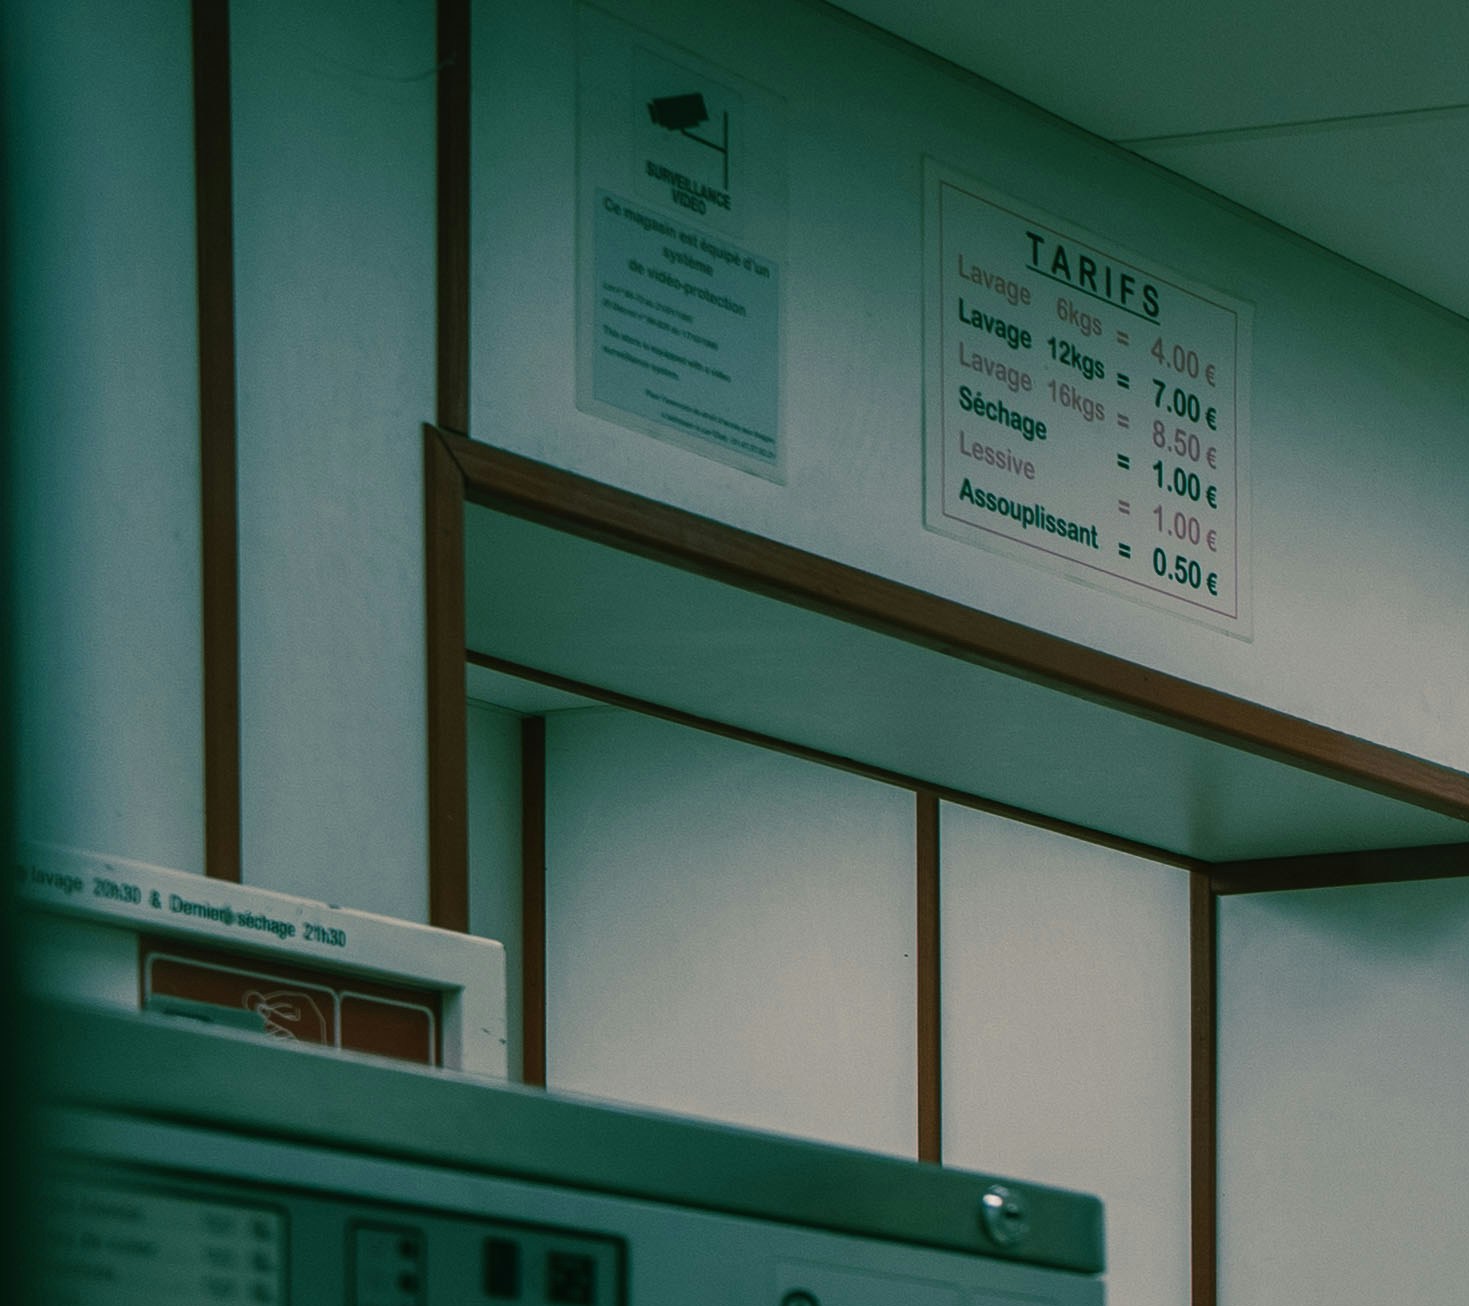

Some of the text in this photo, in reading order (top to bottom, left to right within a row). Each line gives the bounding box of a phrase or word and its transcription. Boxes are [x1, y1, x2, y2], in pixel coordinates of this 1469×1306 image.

[958, 253, 1199, 379] Lavage 6kgs 4.00
[1025, 230, 1160, 318] TARIFS
[958, 297, 1200, 423] Lavage 12kgs 7.00
[958, 341, 1200, 462] Lavage 16kgs 8.50
[959, 385, 1200, 502] Séchage 1.00
[959, 431, 1200, 545] Lessive 1.00
[959, 478, 1201, 589] Assouplissant 0.50
[32, 864, 347, 948] lavage 20h30 séchage 21h30
